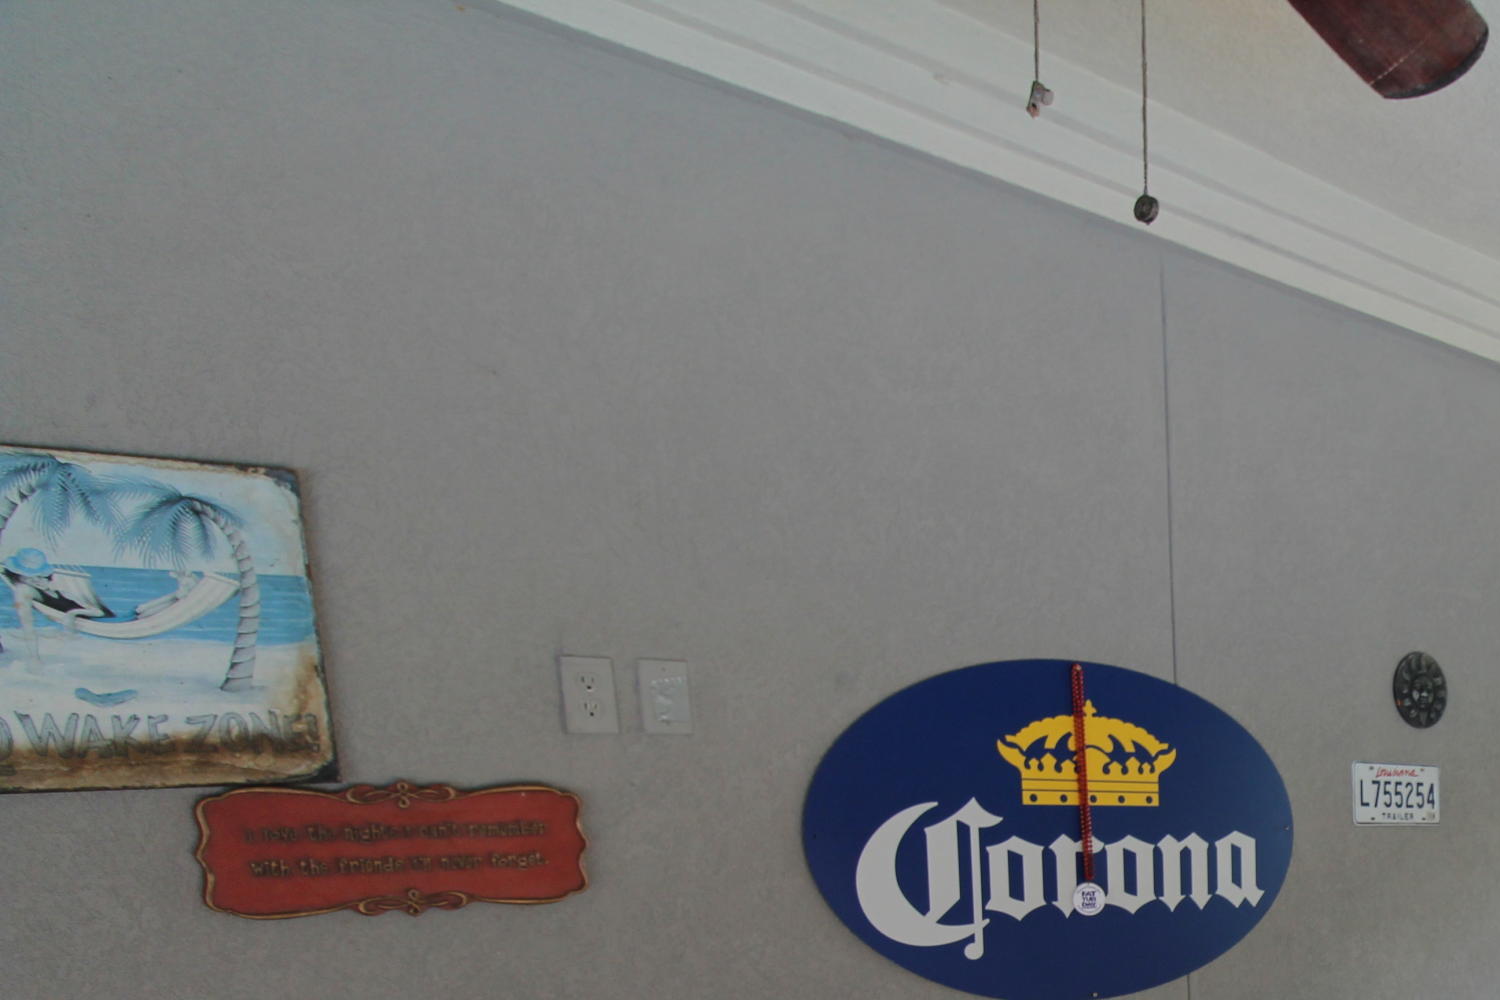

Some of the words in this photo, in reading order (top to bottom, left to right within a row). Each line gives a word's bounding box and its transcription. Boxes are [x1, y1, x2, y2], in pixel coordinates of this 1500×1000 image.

[14, 711, 169, 758] WAKE
[185, 710, 321, 754] ZONE!
[1360, 779, 1436, 809] L755254
[250, 858, 289, 876] with
[856, 797, 1265, 960] Corona
